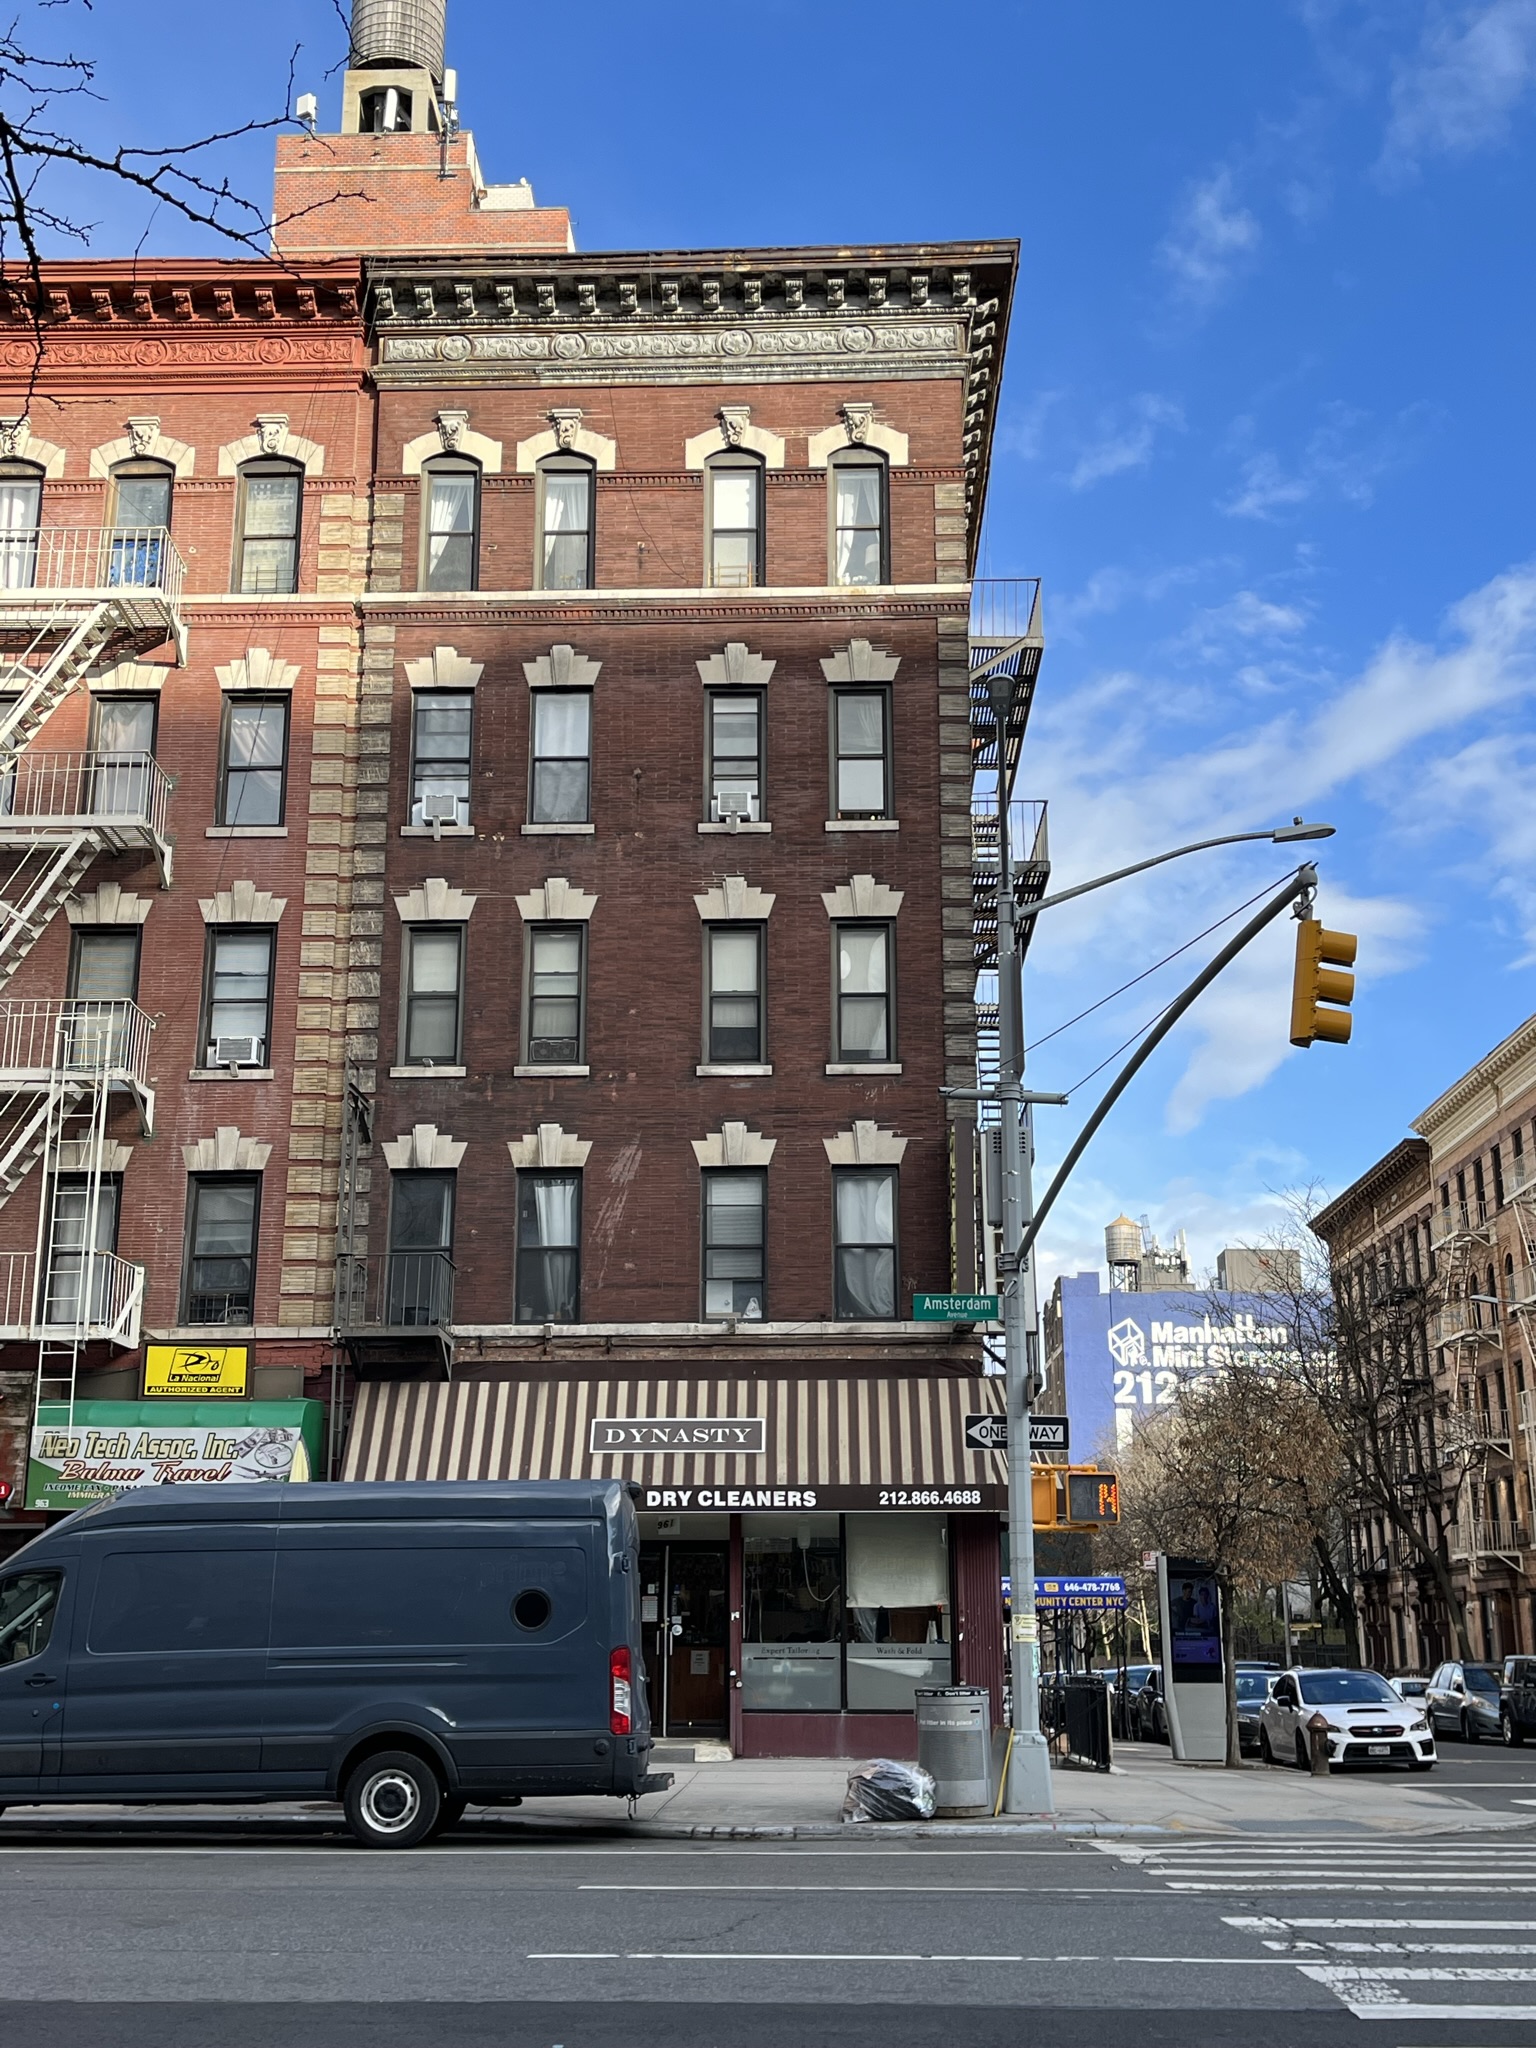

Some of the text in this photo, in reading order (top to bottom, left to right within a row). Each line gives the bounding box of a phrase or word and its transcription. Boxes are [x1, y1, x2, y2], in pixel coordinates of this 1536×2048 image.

[923, 1297, 991, 1310] Amsterdam
[1151, 1313, 1288, 1344] Manhattan
[1152, 1345, 1204, 1368] Mini
[604, 1428, 752, 1444] DYNASTY
[979, 1426, 1060, 1440] ONE WAY
[38, 1431, 239, 1459] Neo Tech Assoc. Inc.
[151, 1460, 233, 1482] Travel
[44, 1483, 81, 1491] INCOME
[83, 1483, 102, 1492] TAX
[646, 1490, 981, 1507] DRY CLEANERS 212.866.4688
[657, 1519, 675, 1529] 961
[1063, 1582, 1121, 1592] 646-478-7768
[1033, 1597, 1125, 1607] MUNITY CENTER NYC
[906, 1647, 923, 1655] Fold
